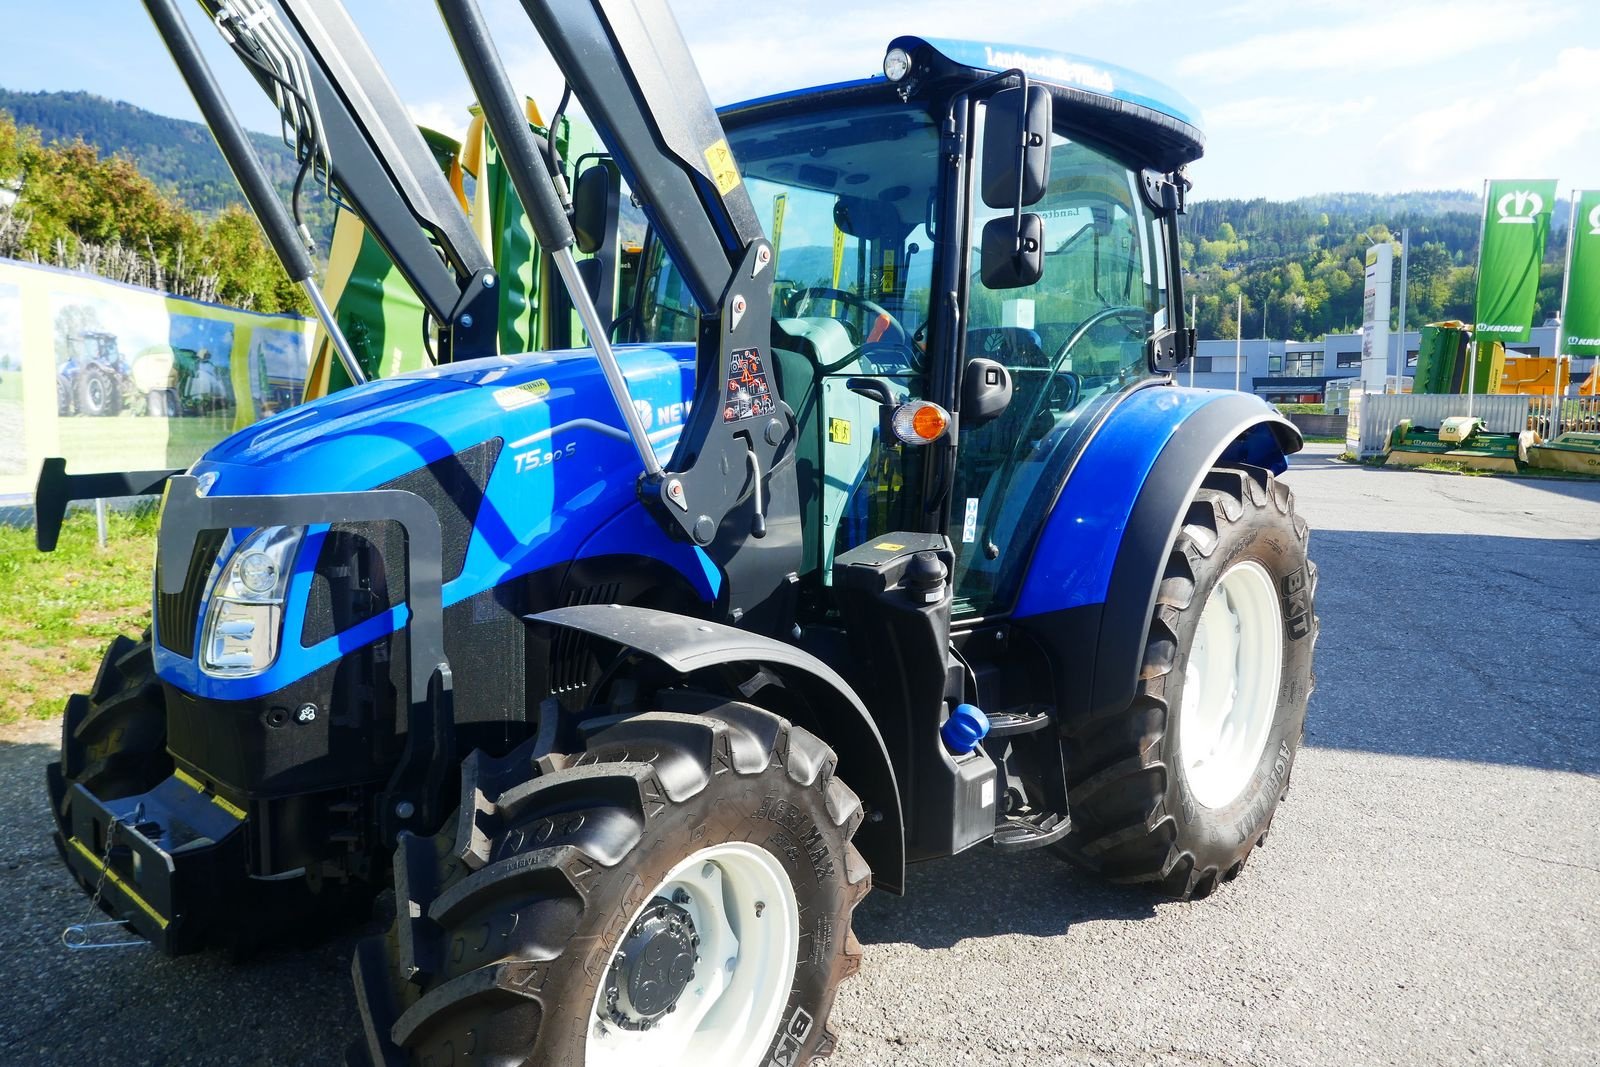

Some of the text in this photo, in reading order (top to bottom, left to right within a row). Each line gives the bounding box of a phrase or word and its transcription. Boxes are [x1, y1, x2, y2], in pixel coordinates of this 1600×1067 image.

[1486, 324, 1524, 333] KRONE
[514, 442, 577, 474] T5.90 S
[1283, 570, 1310, 641] BKT
[752, 796, 836, 884] AGRIMAX
